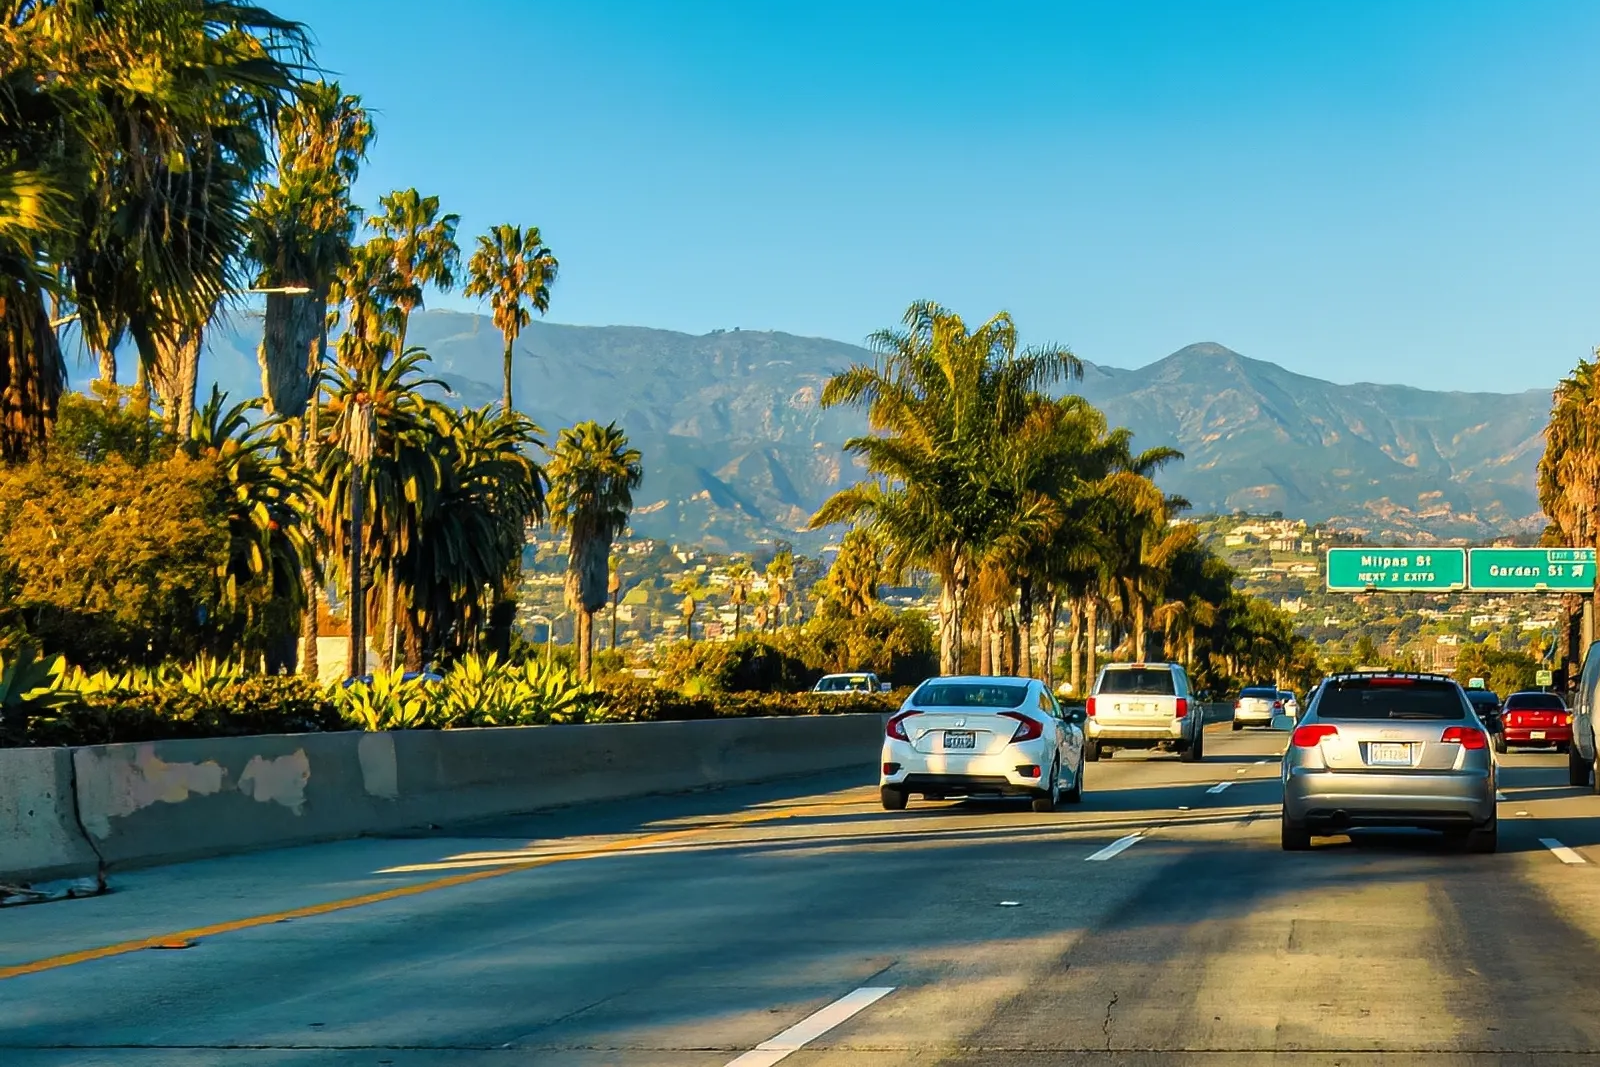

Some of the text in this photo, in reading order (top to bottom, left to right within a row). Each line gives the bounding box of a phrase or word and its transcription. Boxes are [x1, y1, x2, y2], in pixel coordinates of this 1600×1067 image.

[1361, 555, 1432, 569] Milpas St
[1358, 572, 1435, 582] NEXT 2 EXITS
[1489, 564, 1563, 577] Garden St
